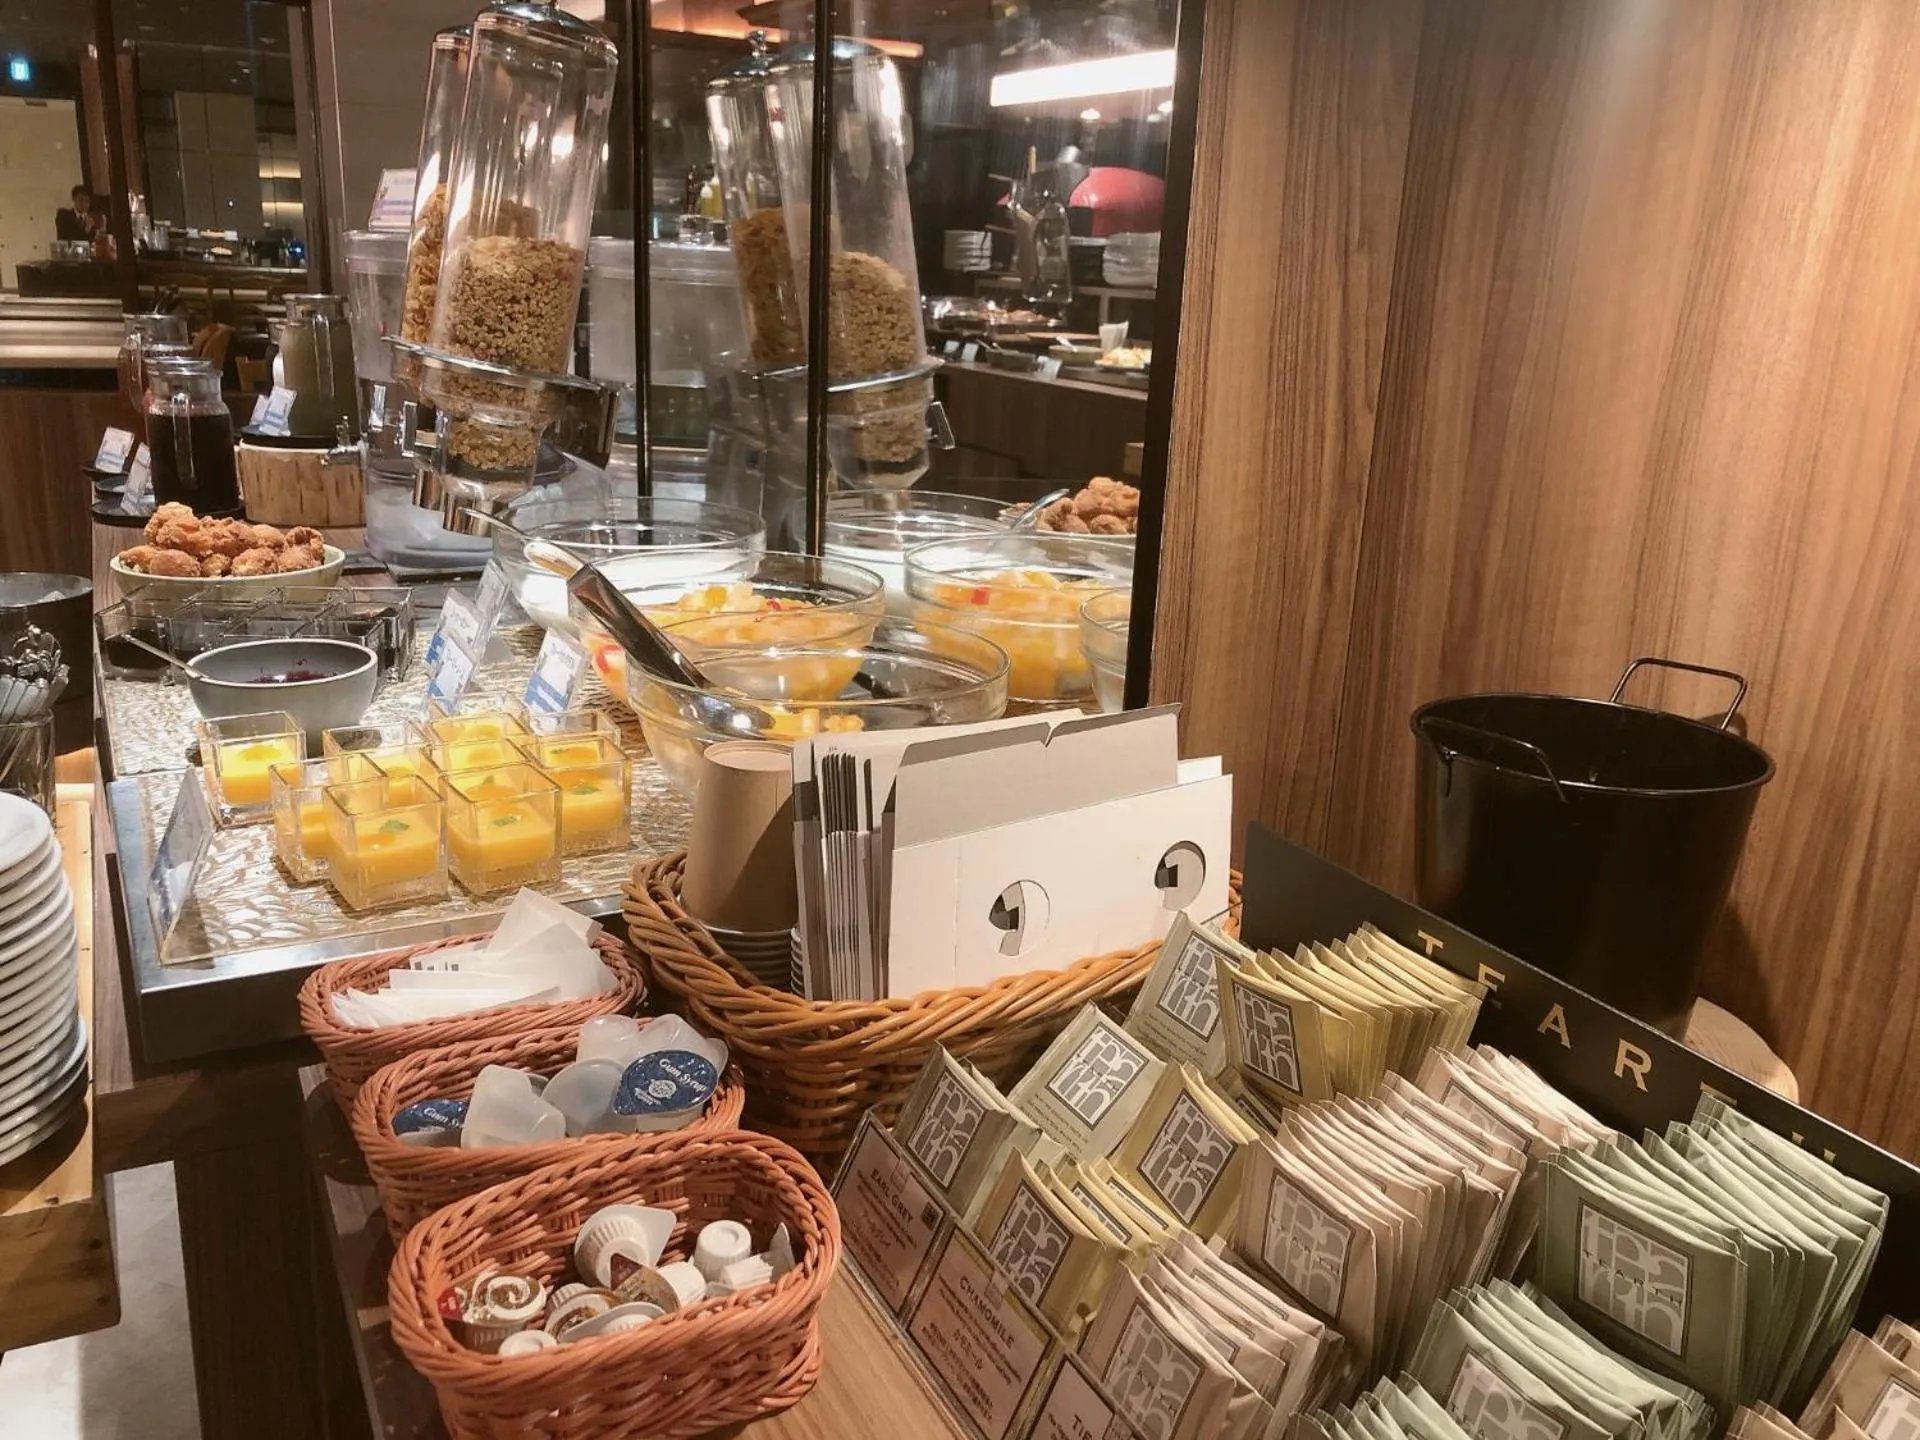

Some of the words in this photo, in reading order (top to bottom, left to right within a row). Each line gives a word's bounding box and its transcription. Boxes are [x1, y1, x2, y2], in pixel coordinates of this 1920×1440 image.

[659, 1058, 682, 1078] Gum
[423, 1107, 449, 1124] Gum
[871, 1168, 890, 1198] EARL
[891, 1194, 914, 1222] GREY
[959, 1275, 1015, 1350] CHAMOMILE
